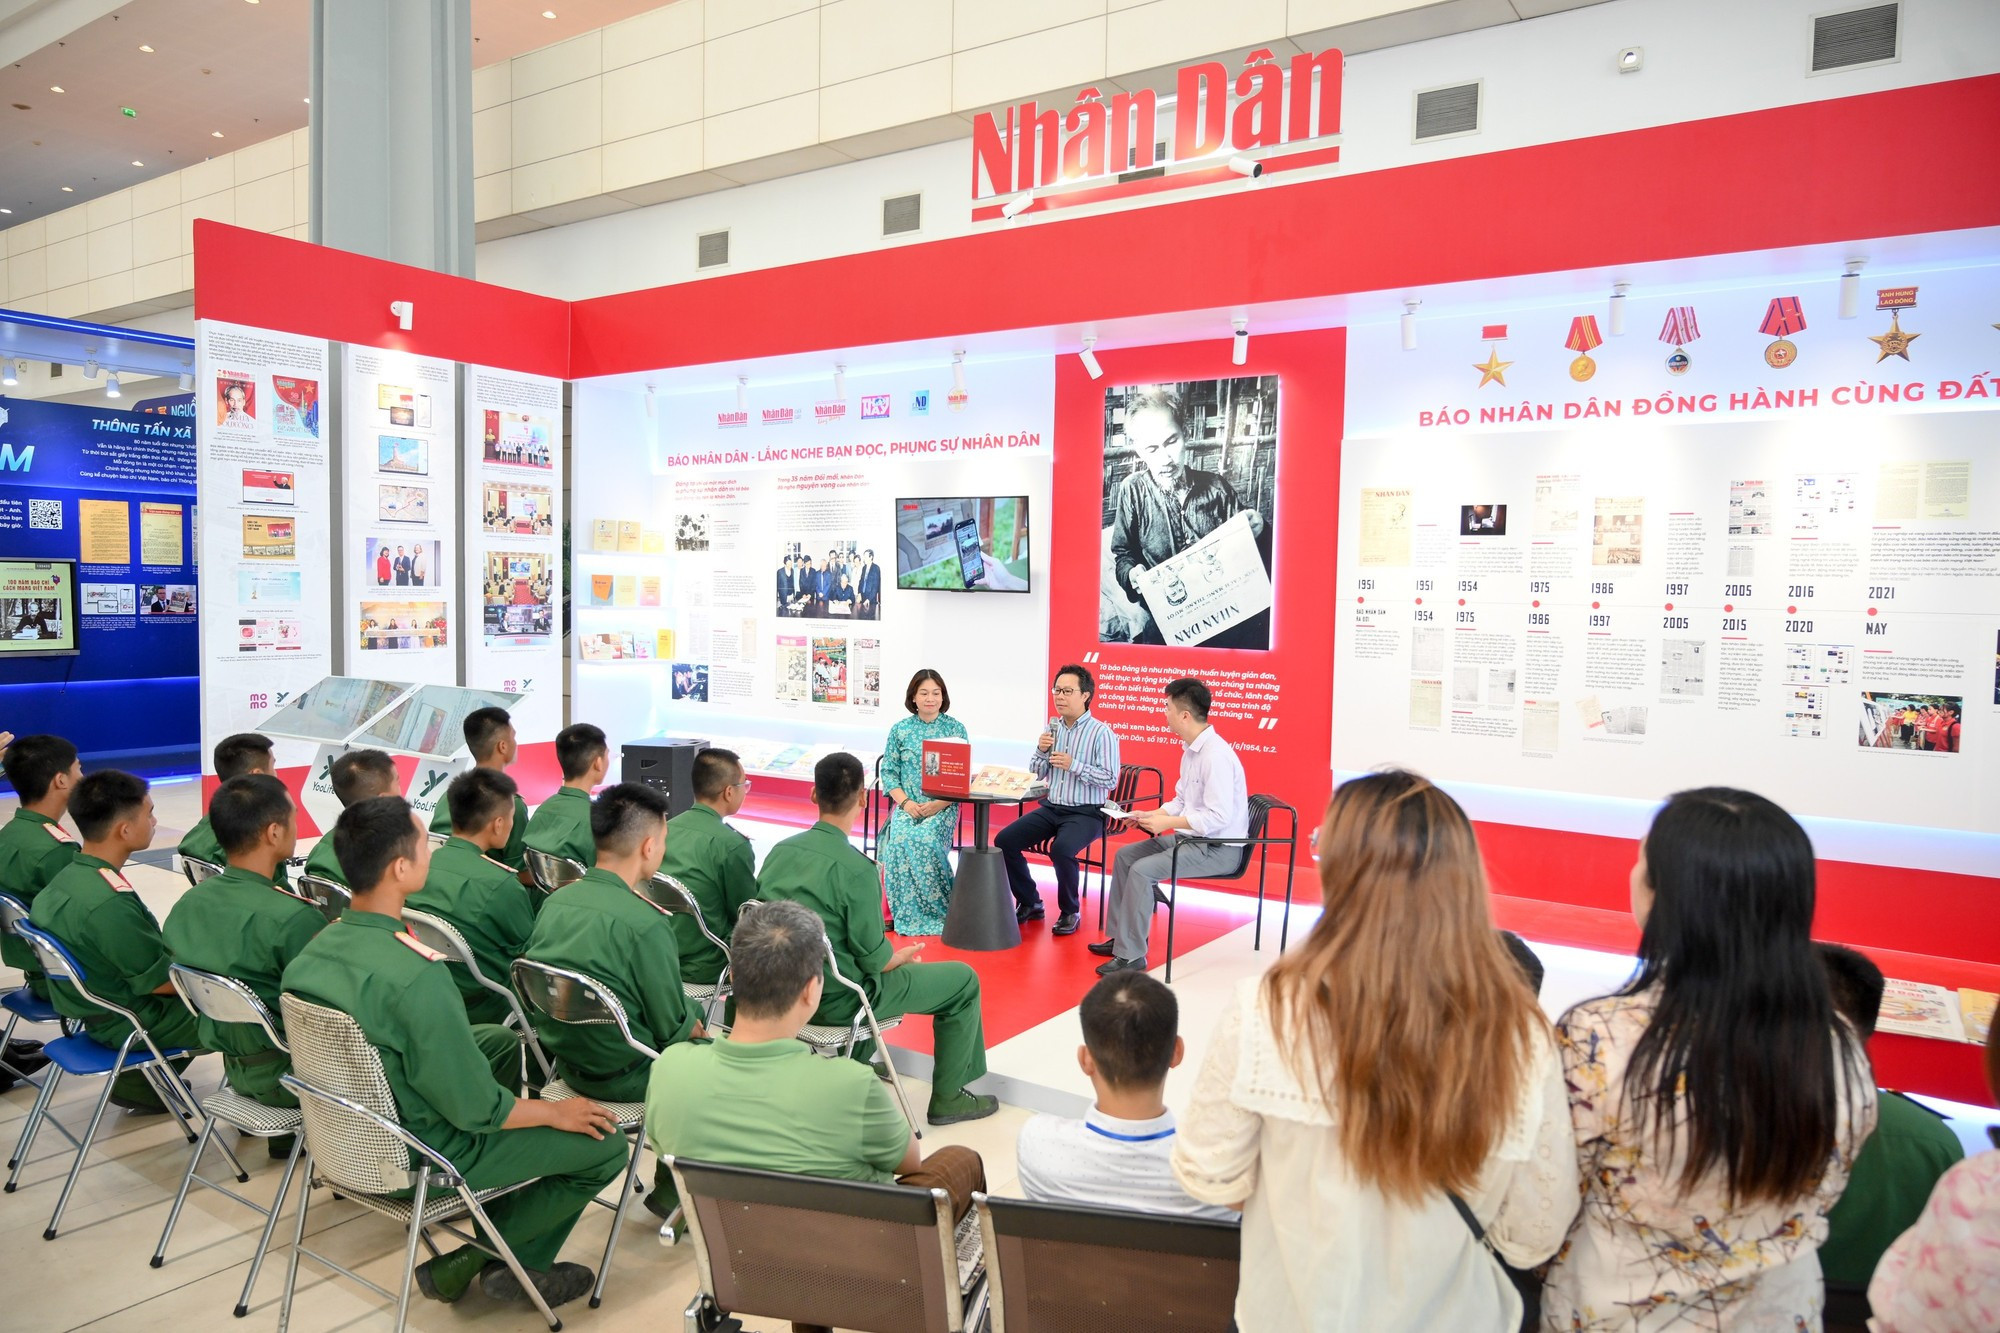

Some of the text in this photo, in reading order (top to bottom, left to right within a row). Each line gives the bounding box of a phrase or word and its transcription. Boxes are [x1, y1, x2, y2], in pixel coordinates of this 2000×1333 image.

[971, 47, 1345, 200] Nhân Dân
[1419, 371, 2000, 428] BÁO NHÂN DÂN ĐỒNG HÀNH CÙNG ĐẤT
[762, 406, 794, 420] Nhân Dân
[815, 402, 846, 415] Nhân Dân
[92, 418, 192, 439] THÔNG TẤN XÃ
[667, 432, 1040, 467] BÁO NHÂN DÂN LẮNG NGHE BẠN ĐỌC, PHỤNG SỰ NHÂN DÂN
[814, 473, 825, 481] Đổi
[796, 482, 819, 491] nguyện
[1358, 579, 1375, 590] 1951
[1416, 580, 1434, 591] 1951
[1458, 581, 1478, 591] 1954
[1530, 581, 1550, 593] 1975
[1591, 582, 1614, 594] 1986
[1666, 584, 1689, 595] 1997
[1725, 584, 1752, 596] 2005
[1788, 585, 1814, 597] 2016
[1868, 586, 1895, 599] 2021
[1414, 610, 1433, 621] 1954
[1456, 611, 1475, 622] 1975
[1528, 613, 1550, 625] 1986
[1589, 615, 1611, 627] 1997
[1663, 617, 1689, 629] 2005
[1722, 618, 1747, 631] 2015
[1785, 620, 1813, 633] 2020
[1866, 622, 1888, 635] NAY
[1121, 664, 1139, 673] Đảng
[1163, 667, 1186, 677] những
[1187, 668, 1199, 677] lớp
[1200, 668, 1219, 677] huấn
[1220, 670, 1240, 679] luyện
[1259, 672, 1277, 681] đơn,
[1115, 674, 1130, 682] thực
[1141, 676, 1157, 685] rộng
[1221, 680, 1244, 690] chúng
[1255, 682, 1280, 692] những
[1128, 684, 1141, 692] biết
[1215, 689, 1223, 697] tổ
[1224, 691, 1244, 699] chức,
[1245, 692, 1262, 700] lãnh
[1263, 693, 1279, 702] đạo
[1108, 693, 1125, 702] công
[1139, 696, 1158, 704] Hàng
[1241, 702, 1259, 710] trình
[1261, 703, 1271, 712] độ
[1098, 701, 1117, 709] chính
[1118, 703, 1126, 712] trị
[1136, 705, 1154, 714] năng
[1219, 710, 1243, 720] chúng
[1113, 722, 1129, 731] phải
[1146, 724, 1160, 732] báo
[1130, 734, 1145, 743] Dân,
[1147, 734, 1156, 742] số
[1156, 736, 1169, 744] 197,
[1263, 745, 1277, 753] tr.2.
[413, 798, 436, 813] YooLif
